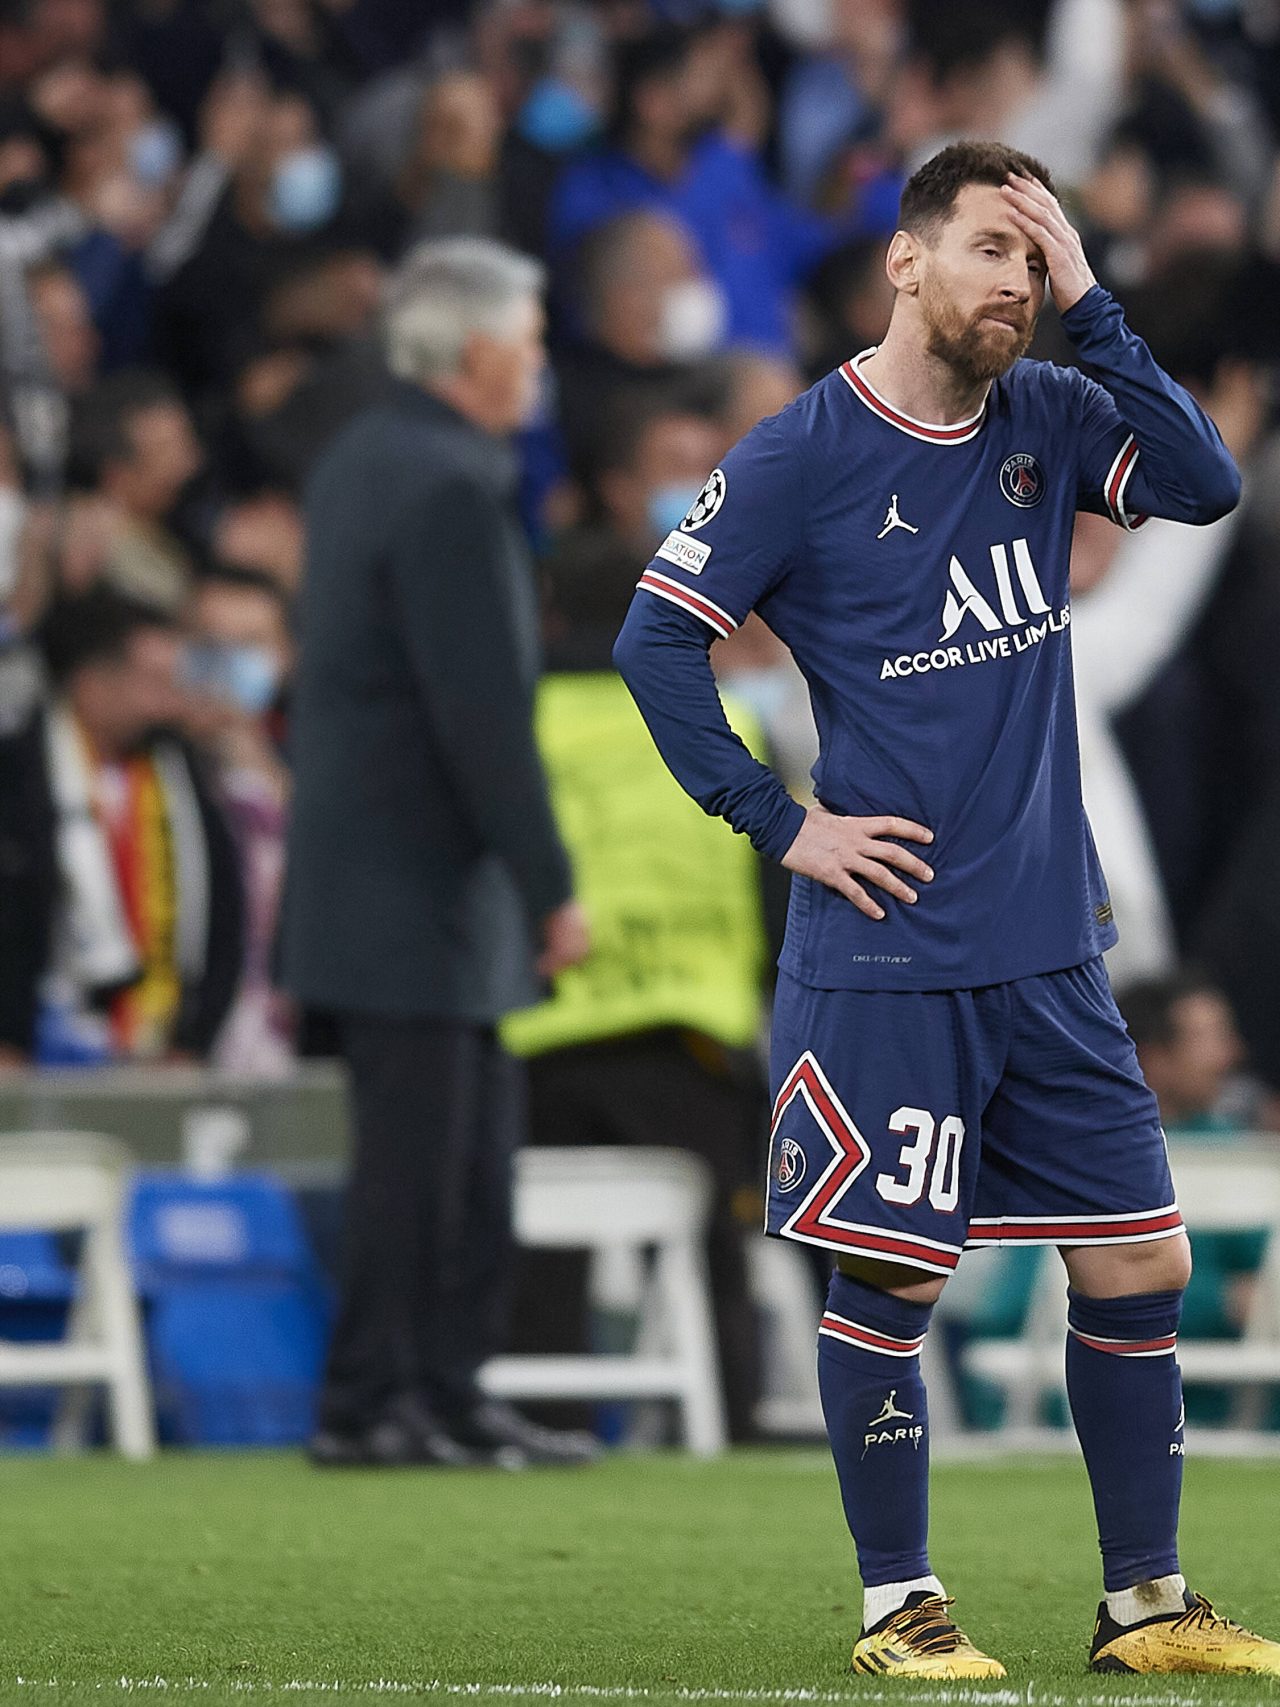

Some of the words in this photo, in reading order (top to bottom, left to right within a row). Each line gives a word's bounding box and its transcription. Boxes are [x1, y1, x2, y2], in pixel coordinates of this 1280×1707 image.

[1004, 456, 1034, 473] PARIS
[880, 648, 965, 680] ACCOR
[966, 637, 1012, 664] LIVE
[876, 1106, 966, 1214] 30
[864, 1425, 923, 1446] PARIS
